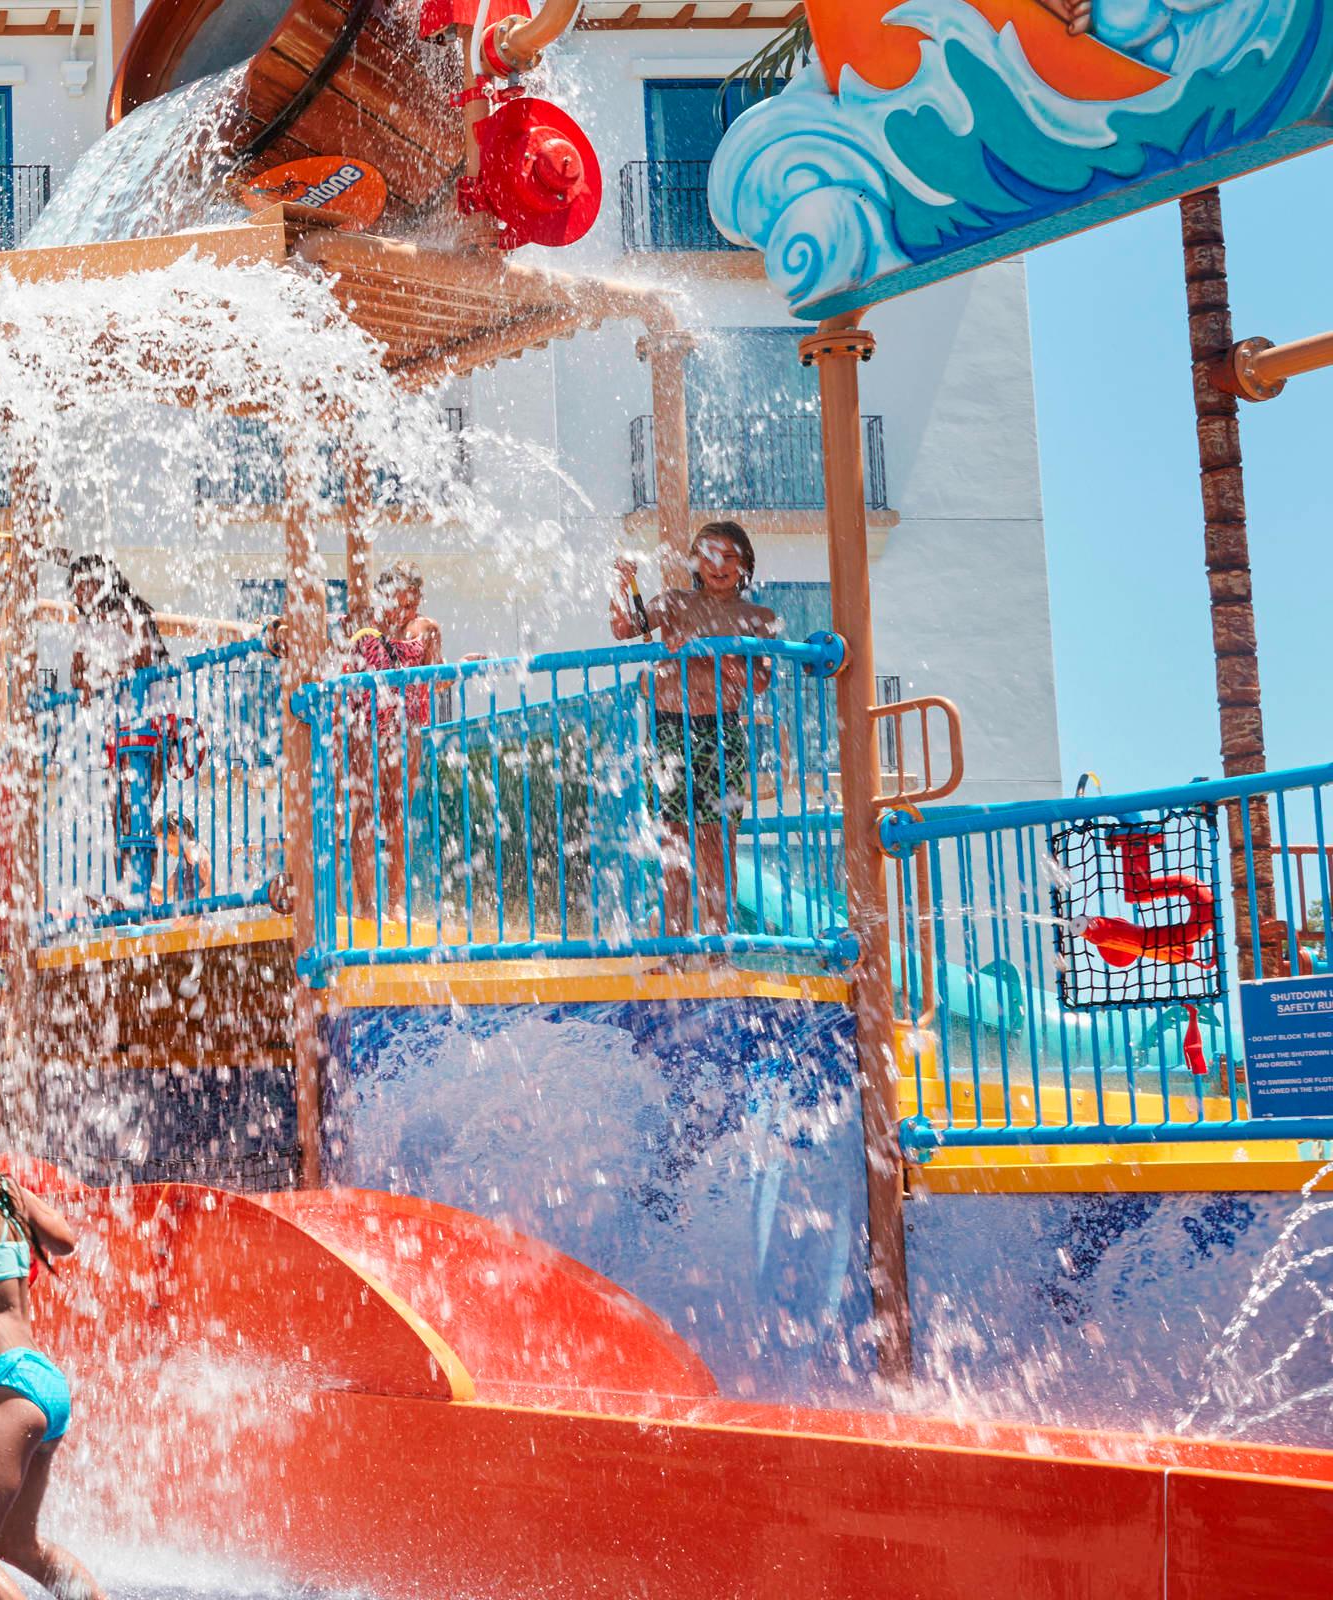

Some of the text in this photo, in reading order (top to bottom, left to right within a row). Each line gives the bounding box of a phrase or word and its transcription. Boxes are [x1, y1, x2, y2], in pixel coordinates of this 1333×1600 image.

[1270, 991, 1327, 1001] SHUTDOWN
[1277, 1003, 1314, 1012] SAFETY
[1258, 1087, 1290, 1095] ALLOWED
